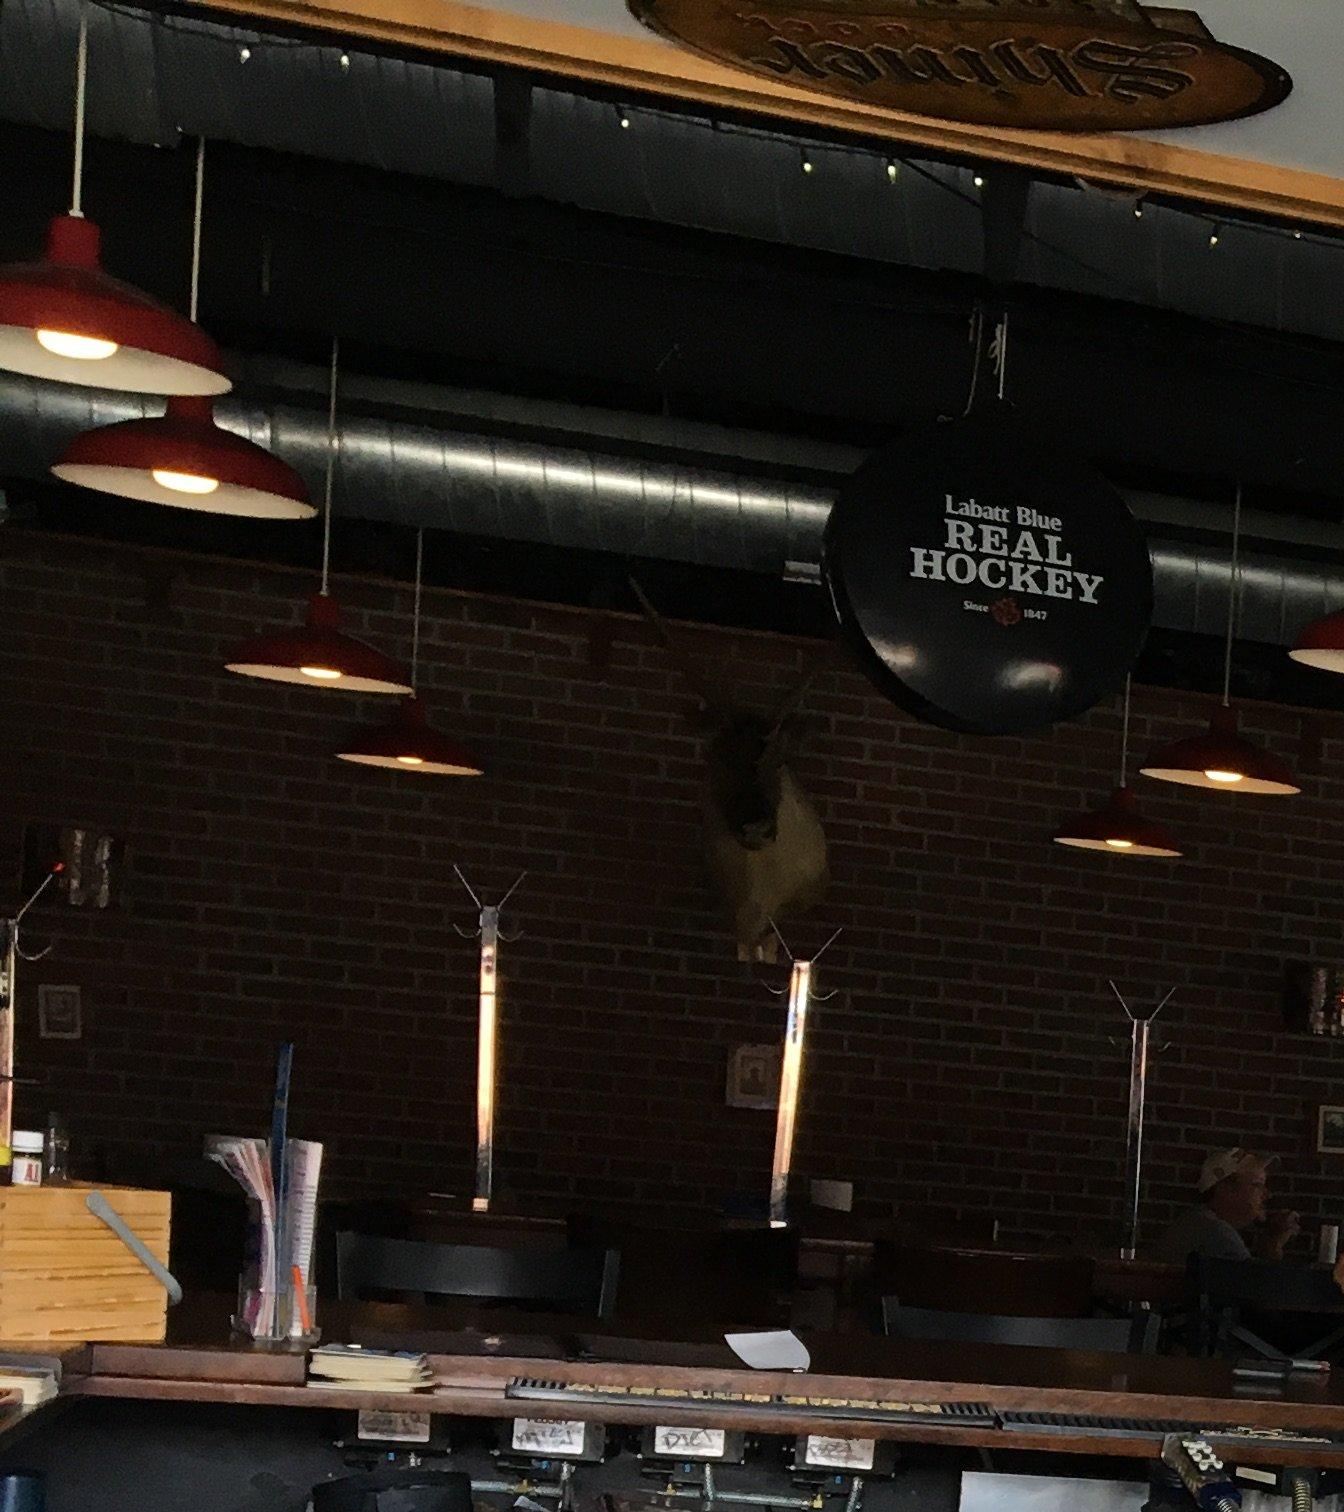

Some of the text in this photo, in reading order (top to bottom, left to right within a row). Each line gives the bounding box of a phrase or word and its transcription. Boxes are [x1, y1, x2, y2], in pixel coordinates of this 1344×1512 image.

[945, 494, 1063, 532] Labatt Blue
[943, 518, 1073, 567] REAL
[909, 546, 1104, 605] HOCKEY
[963, 600, 1047, 620] Since 1847
